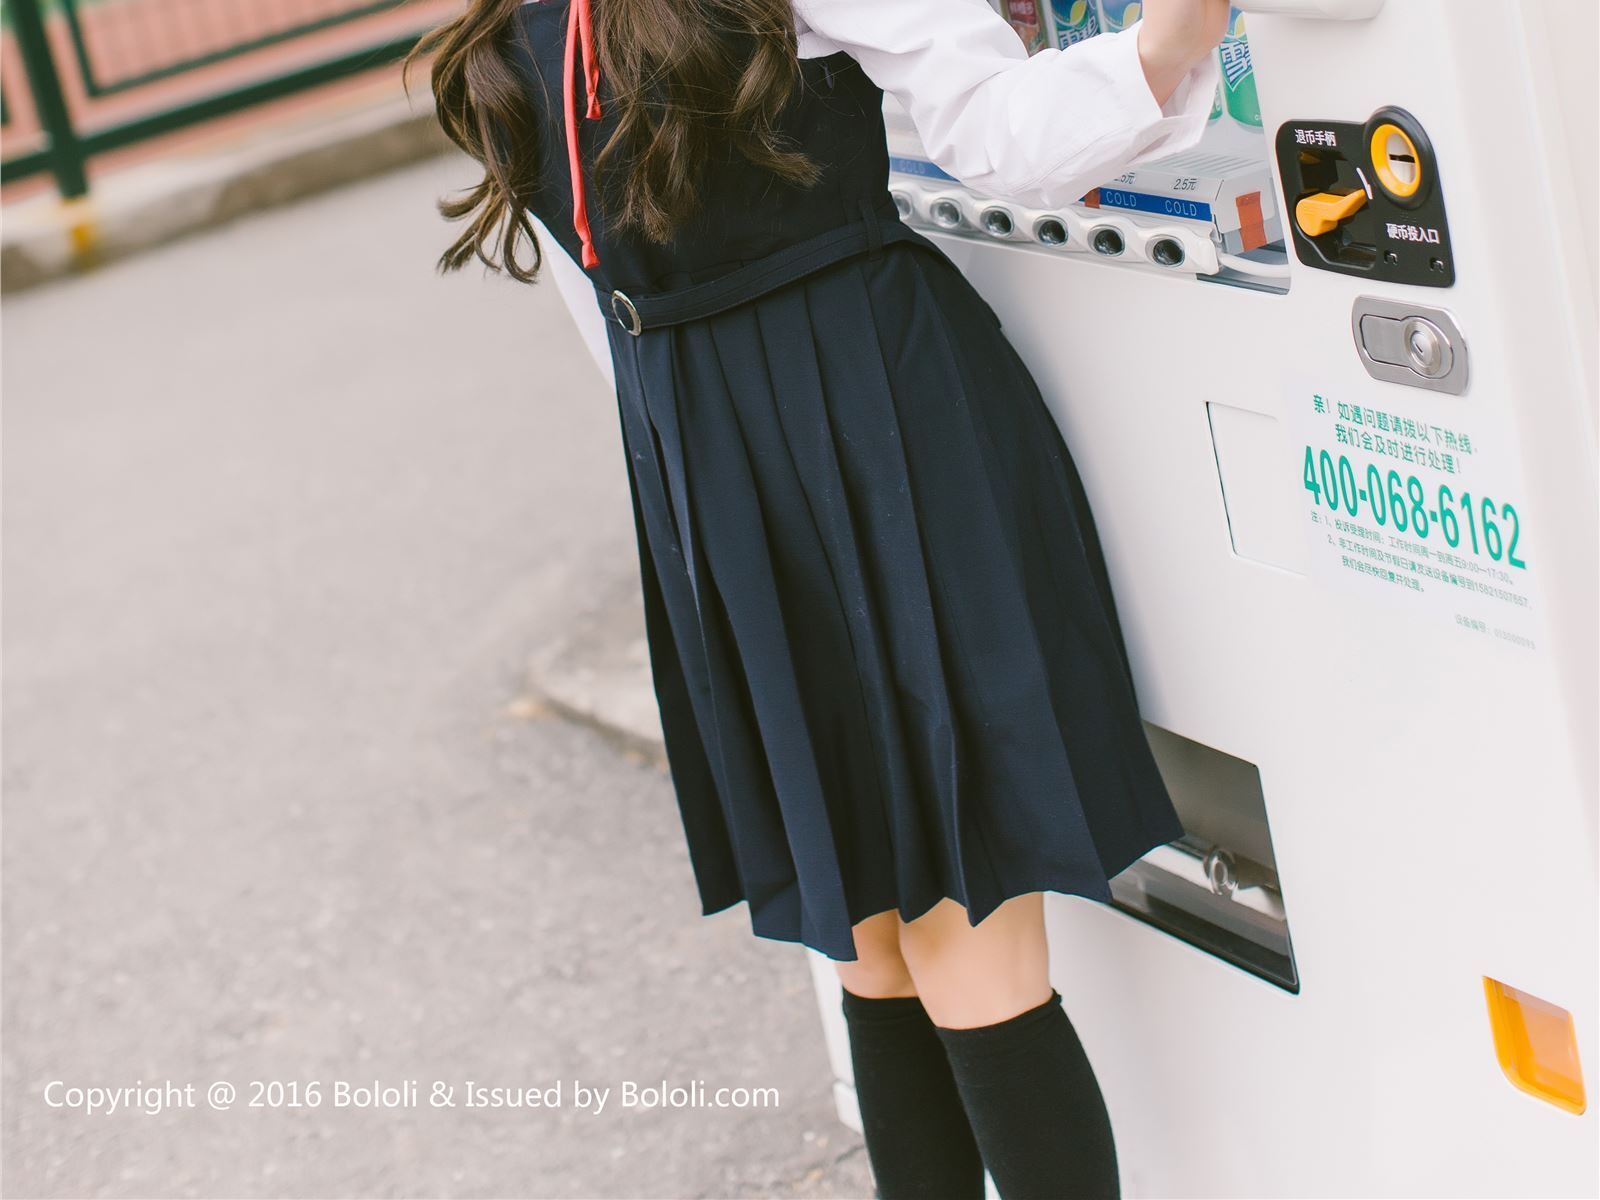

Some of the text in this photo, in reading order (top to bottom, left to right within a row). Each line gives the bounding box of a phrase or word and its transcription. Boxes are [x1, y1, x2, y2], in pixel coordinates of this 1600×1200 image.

[1294, 128, 1337, 147] 退币手柄
[1173, 178, 1198, 191] 2.5元
[1106, 191, 1197, 217] COLD COLD
[1385, 223, 1440, 244] 硬币投入口
[1303, 445, 1527, 570] 400-068-6162
